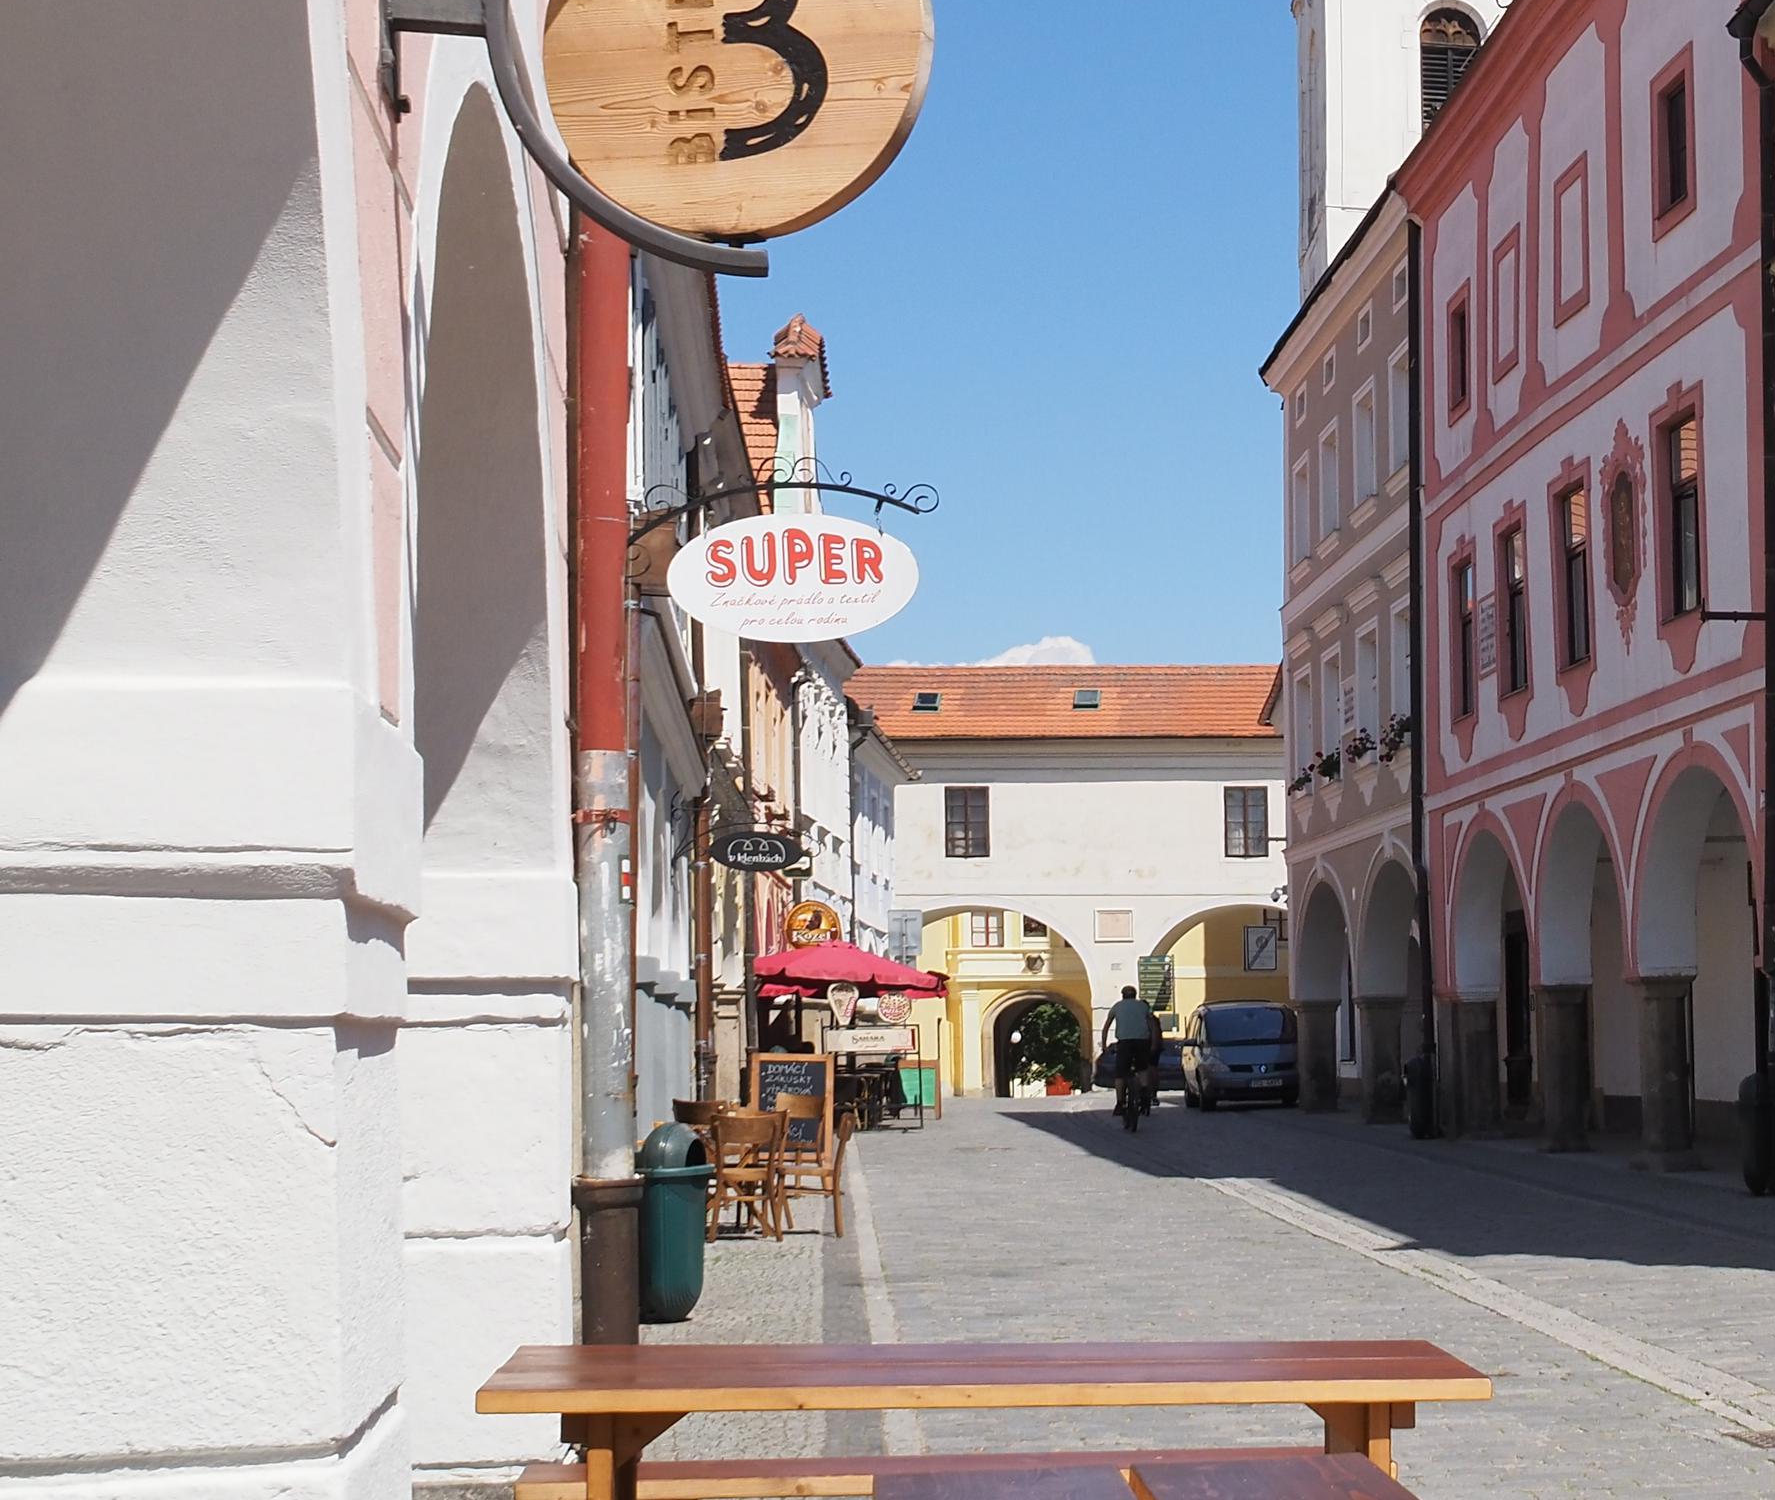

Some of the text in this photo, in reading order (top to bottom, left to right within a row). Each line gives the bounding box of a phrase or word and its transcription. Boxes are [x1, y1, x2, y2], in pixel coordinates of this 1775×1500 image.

[705, 528, 883, 587] SUPER
[710, 592, 776, 607] Značkové
[828, 596, 834, 604] a
[840, 590, 881, 604] textil
[739, 612, 848, 630] pro celou rodinu
